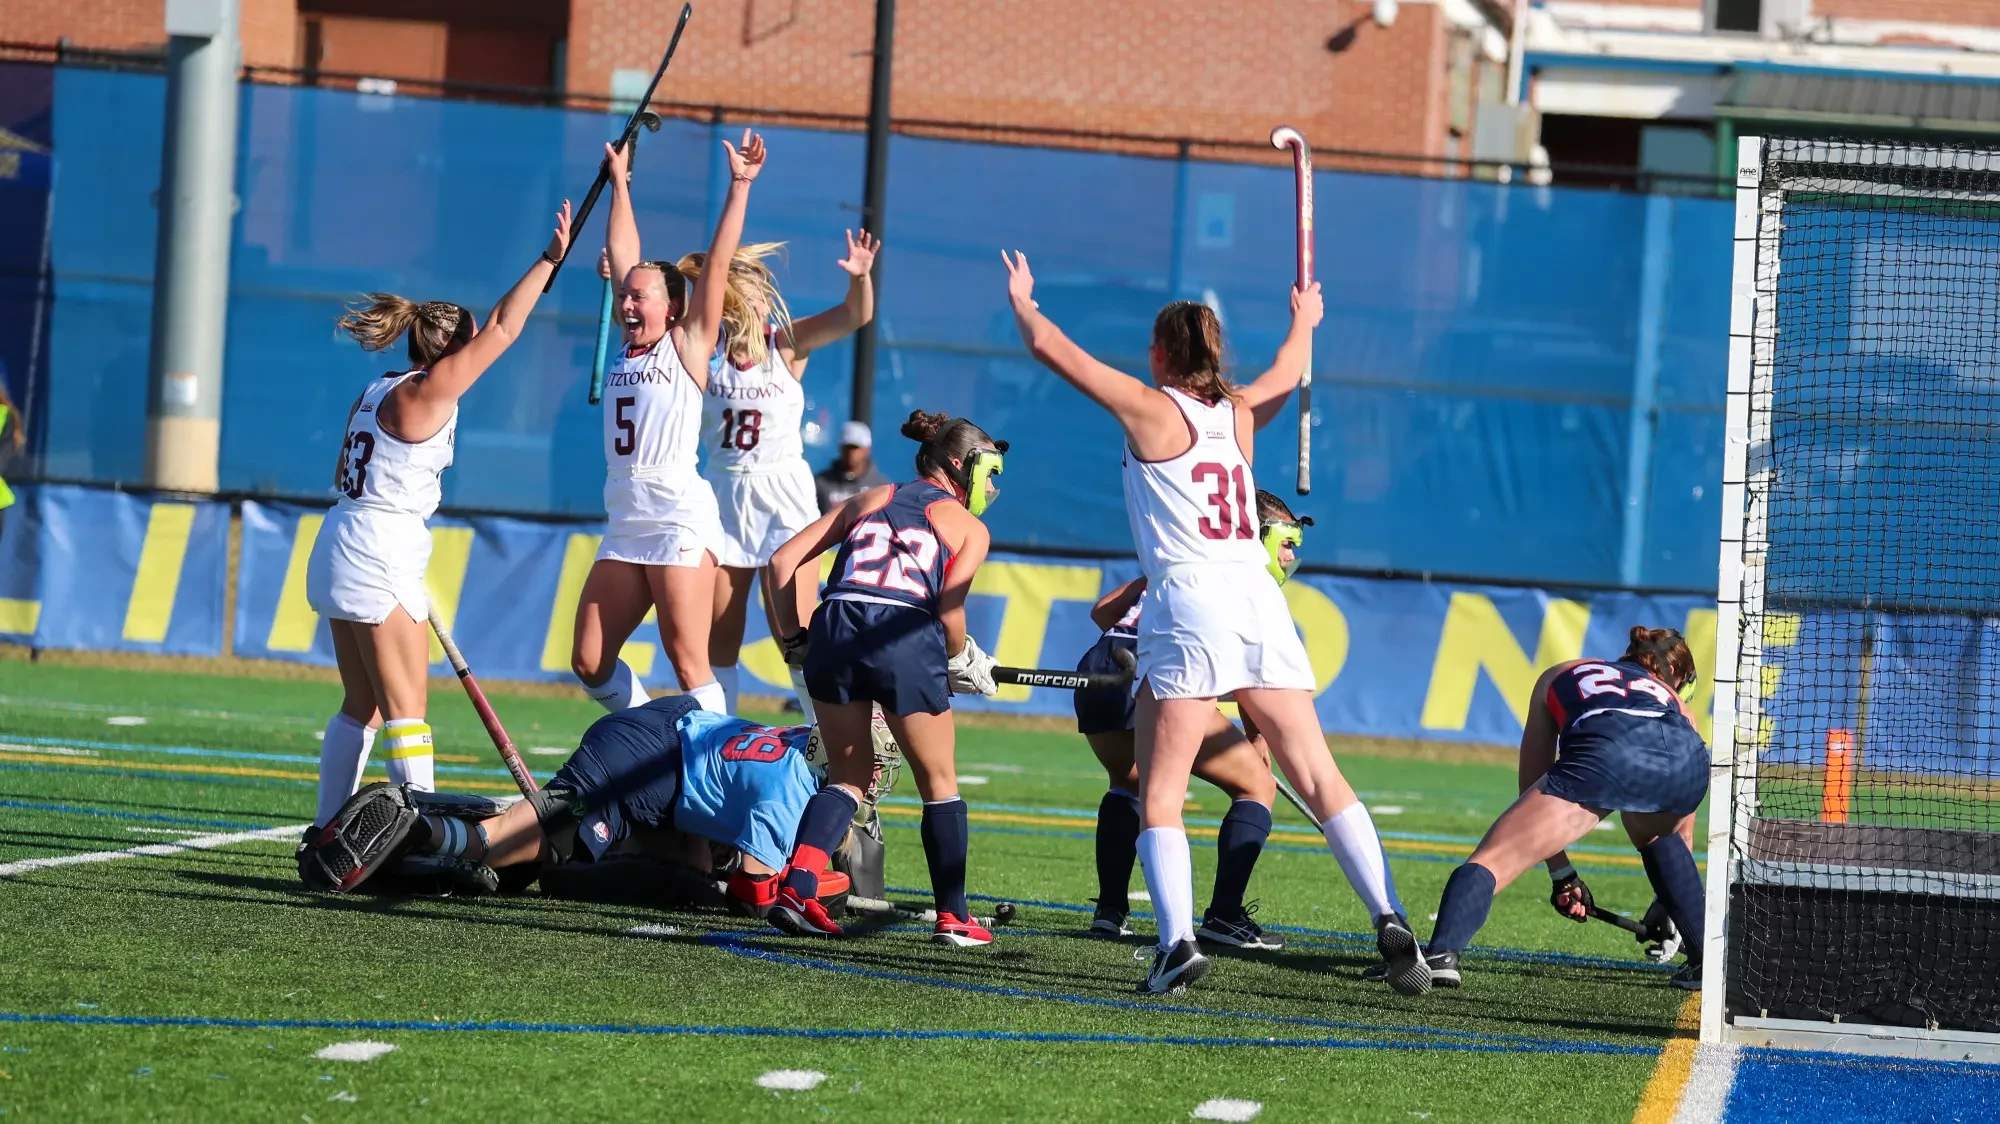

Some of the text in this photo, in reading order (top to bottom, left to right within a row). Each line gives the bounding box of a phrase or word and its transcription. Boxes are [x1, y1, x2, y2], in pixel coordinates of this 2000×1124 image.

[614, 396, 635, 456] 5
[720, 408, 762, 451] 18
[1191, 462, 1254, 540] 31
[841, 520, 940, 600] 22
[1016, 672, 1089, 688] mercian
[1571, 663, 1674, 707] 24
[805, 735, 819, 762] OBO
